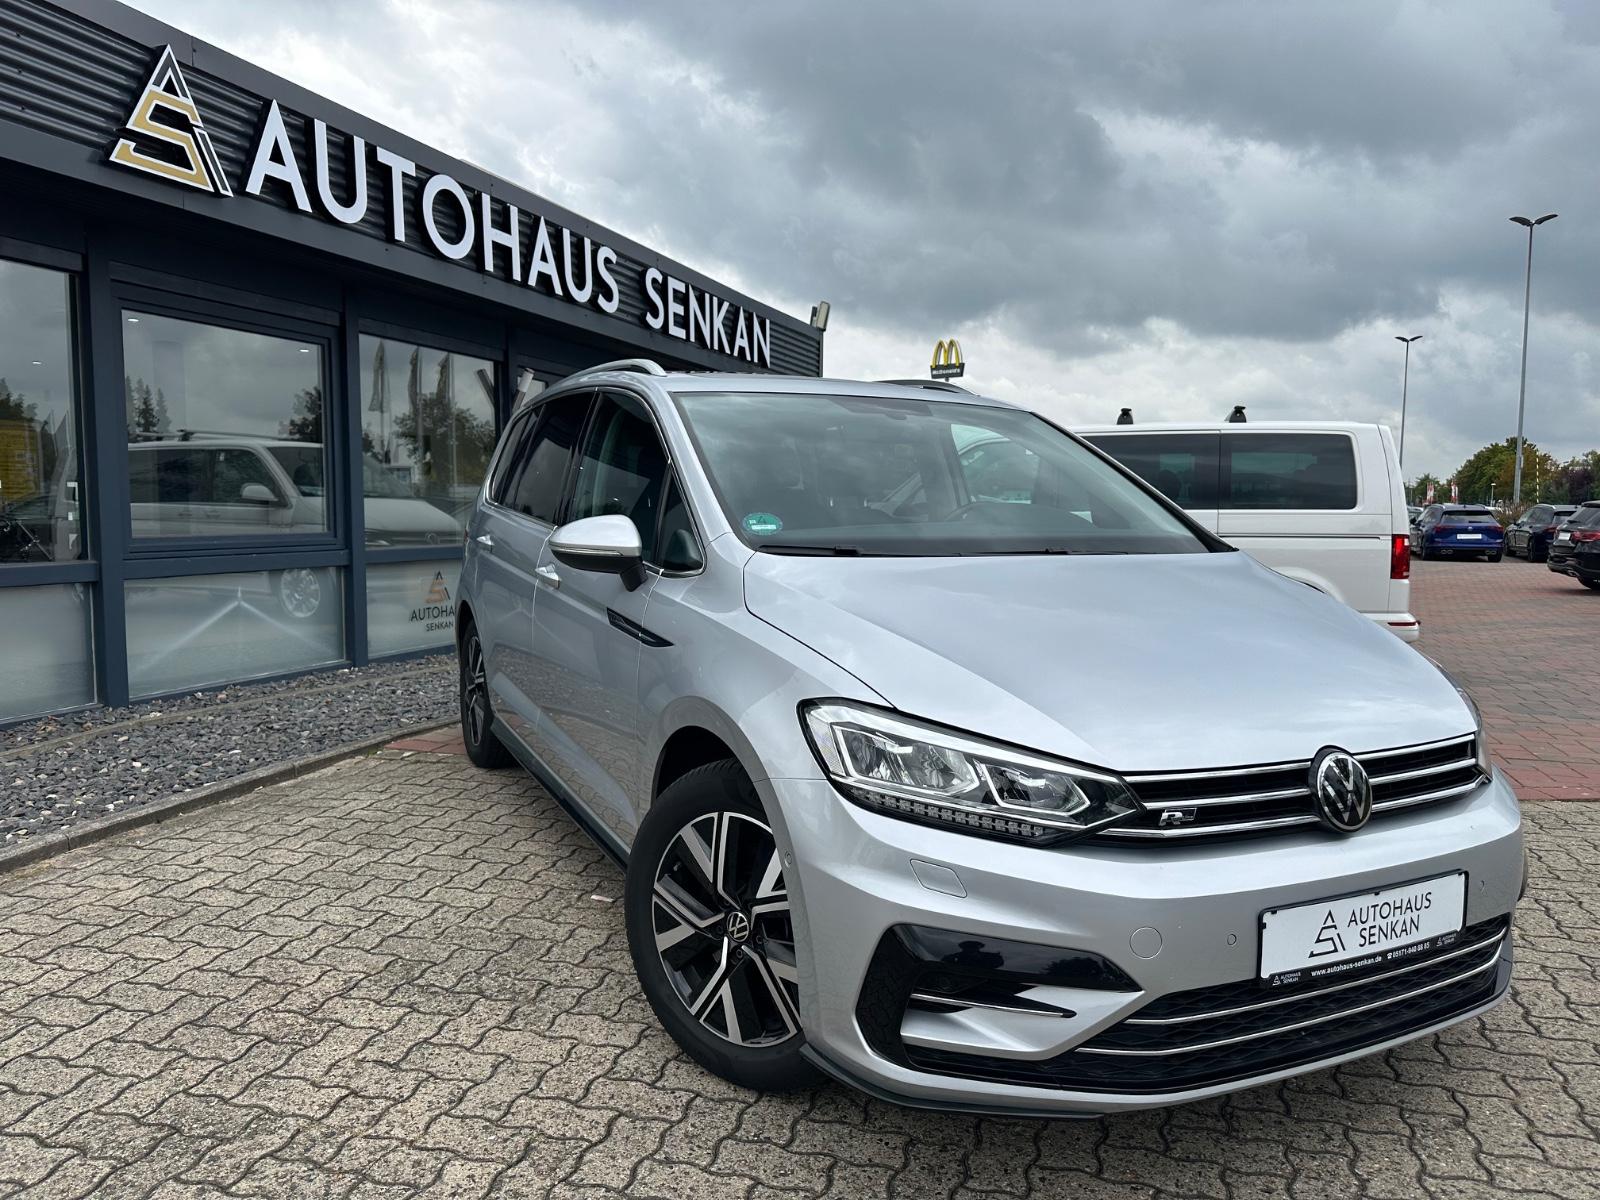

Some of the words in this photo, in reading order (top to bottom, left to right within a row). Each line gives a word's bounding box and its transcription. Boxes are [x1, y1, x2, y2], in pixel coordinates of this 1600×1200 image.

[245, 99, 620, 314] AUTOHAUS
[644, 267, 771, 368] SENKAN
[426, 621, 454, 632] SENKAN
[1347, 891, 1432, 928] AUTOHAUS
[1358, 915, 1420, 948] SENKAN
[1310, 956, 1382, 977] www.autohaus-senkan.de
